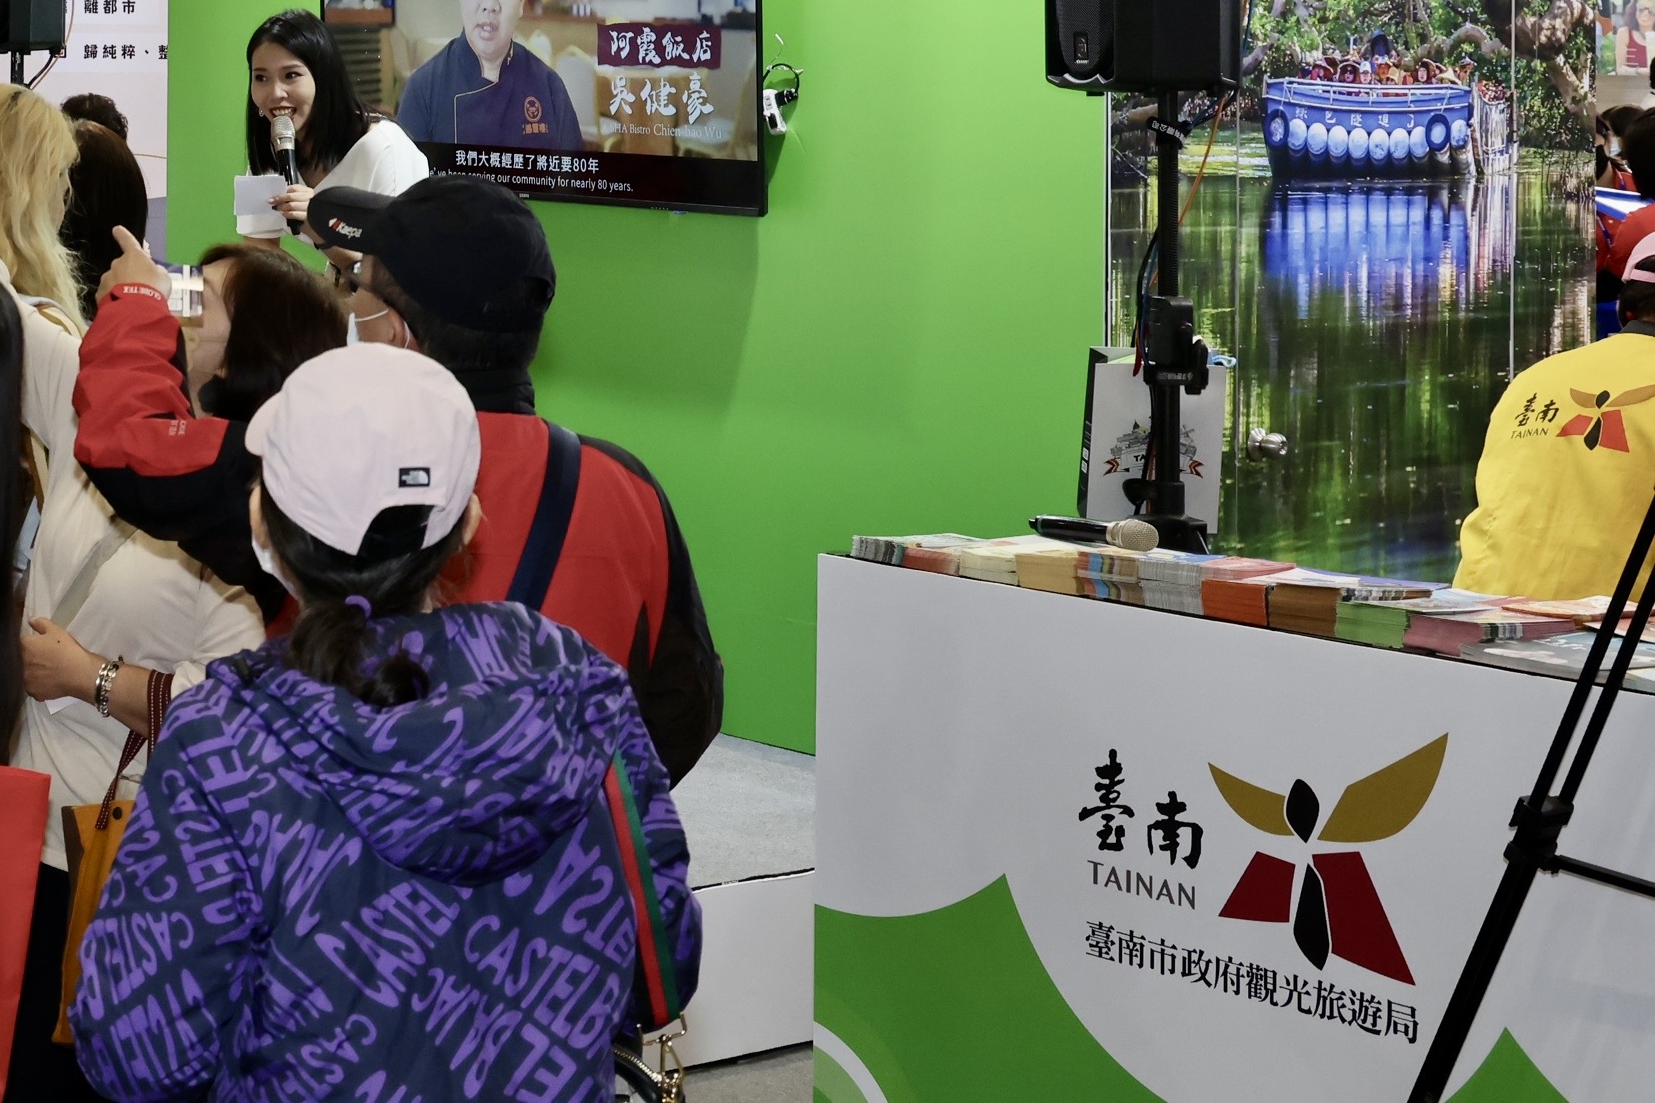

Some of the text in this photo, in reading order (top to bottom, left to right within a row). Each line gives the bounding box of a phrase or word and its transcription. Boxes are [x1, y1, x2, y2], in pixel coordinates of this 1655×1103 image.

[610, 27, 712, 65] 阿霞飯店
[610, 73, 715, 125] 吳健豪
[629, 124, 651, 135] Bistro
[704, 126, 722, 138] Wu
[455, 149, 599, 174] 我們大概經歷了將近要80年
[497, 174, 511, 184] our
[512, 174, 556, 189] community
[557, 176, 569, 188] for
[571, 177, 596, 192] nearly
[597, 178, 608, 190] 80
[609, 181, 634, 193] years.
[1514, 392, 1559, 427] 臺南
[1511, 427, 1549, 440] TAINAN
[1079, 748, 1203, 869] 臺南
[1087, 860, 1196, 910] TAINAN
[1085, 921, 1419, 1045] 臺南市政府觀光旅遊局
